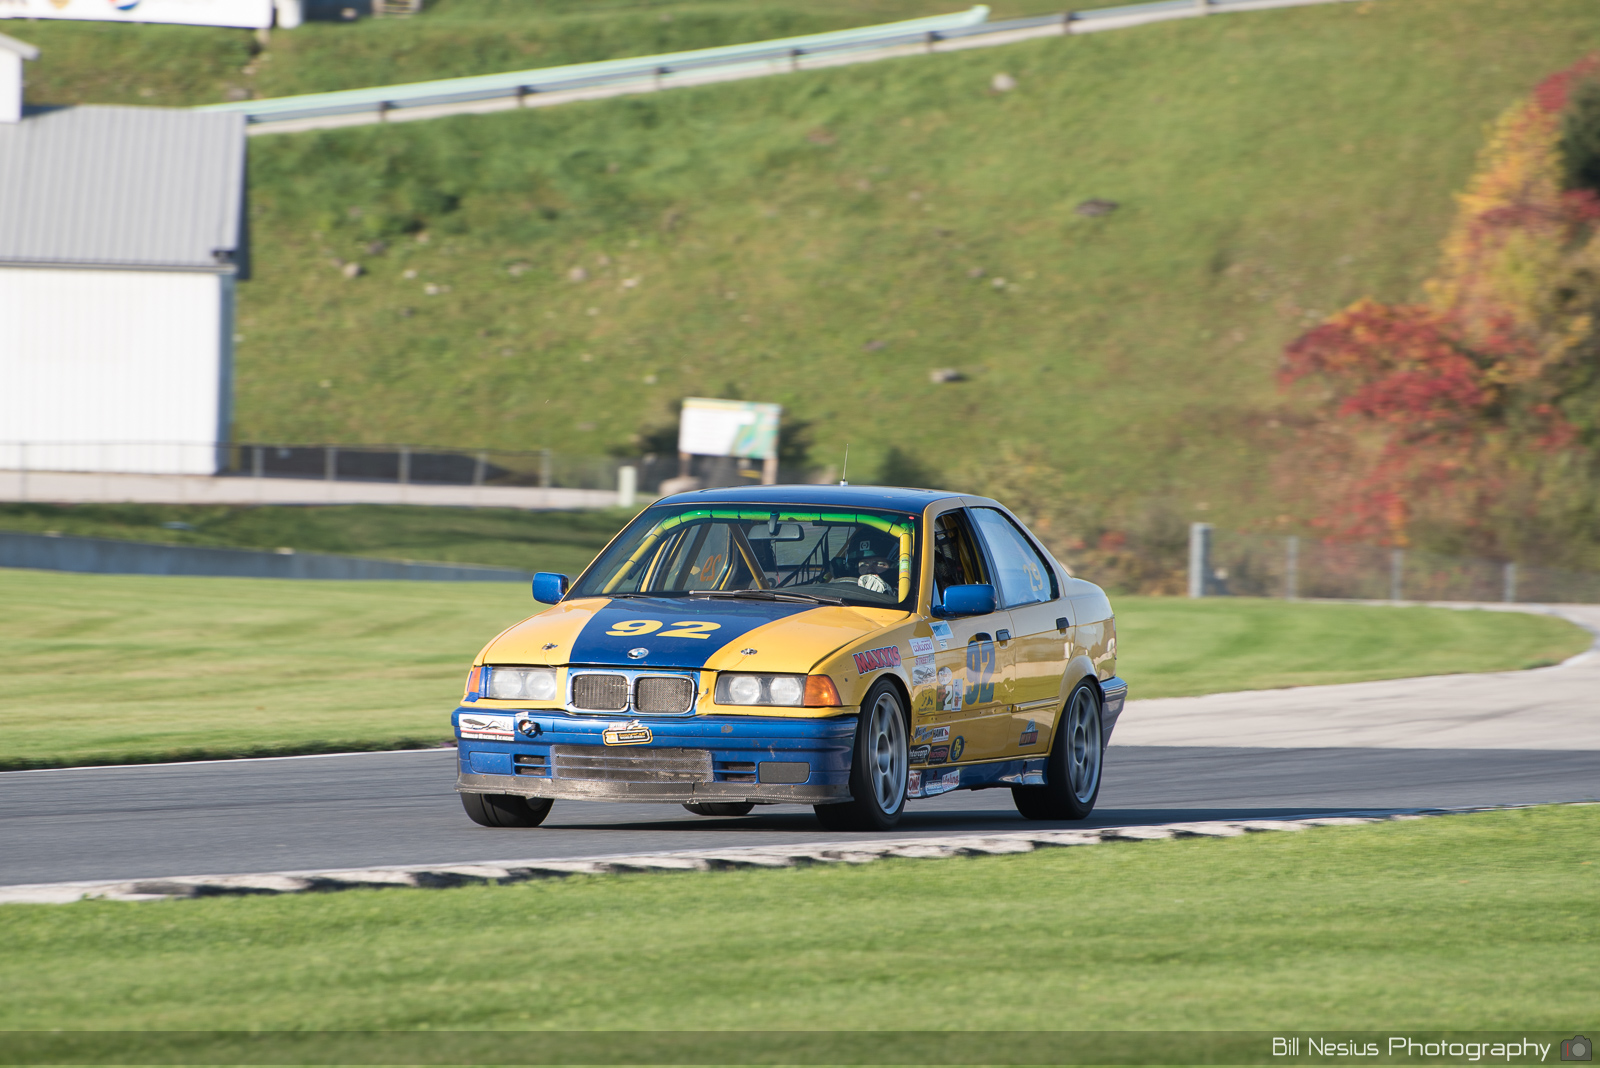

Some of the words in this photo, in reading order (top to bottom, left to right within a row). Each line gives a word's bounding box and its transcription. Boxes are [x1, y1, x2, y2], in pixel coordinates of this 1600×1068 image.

[1022, 562, 1043, 592] 29
[606, 620, 721, 639] 92
[852, 645, 901, 675] MAXXIS
[965, 637, 995, 705] 92
